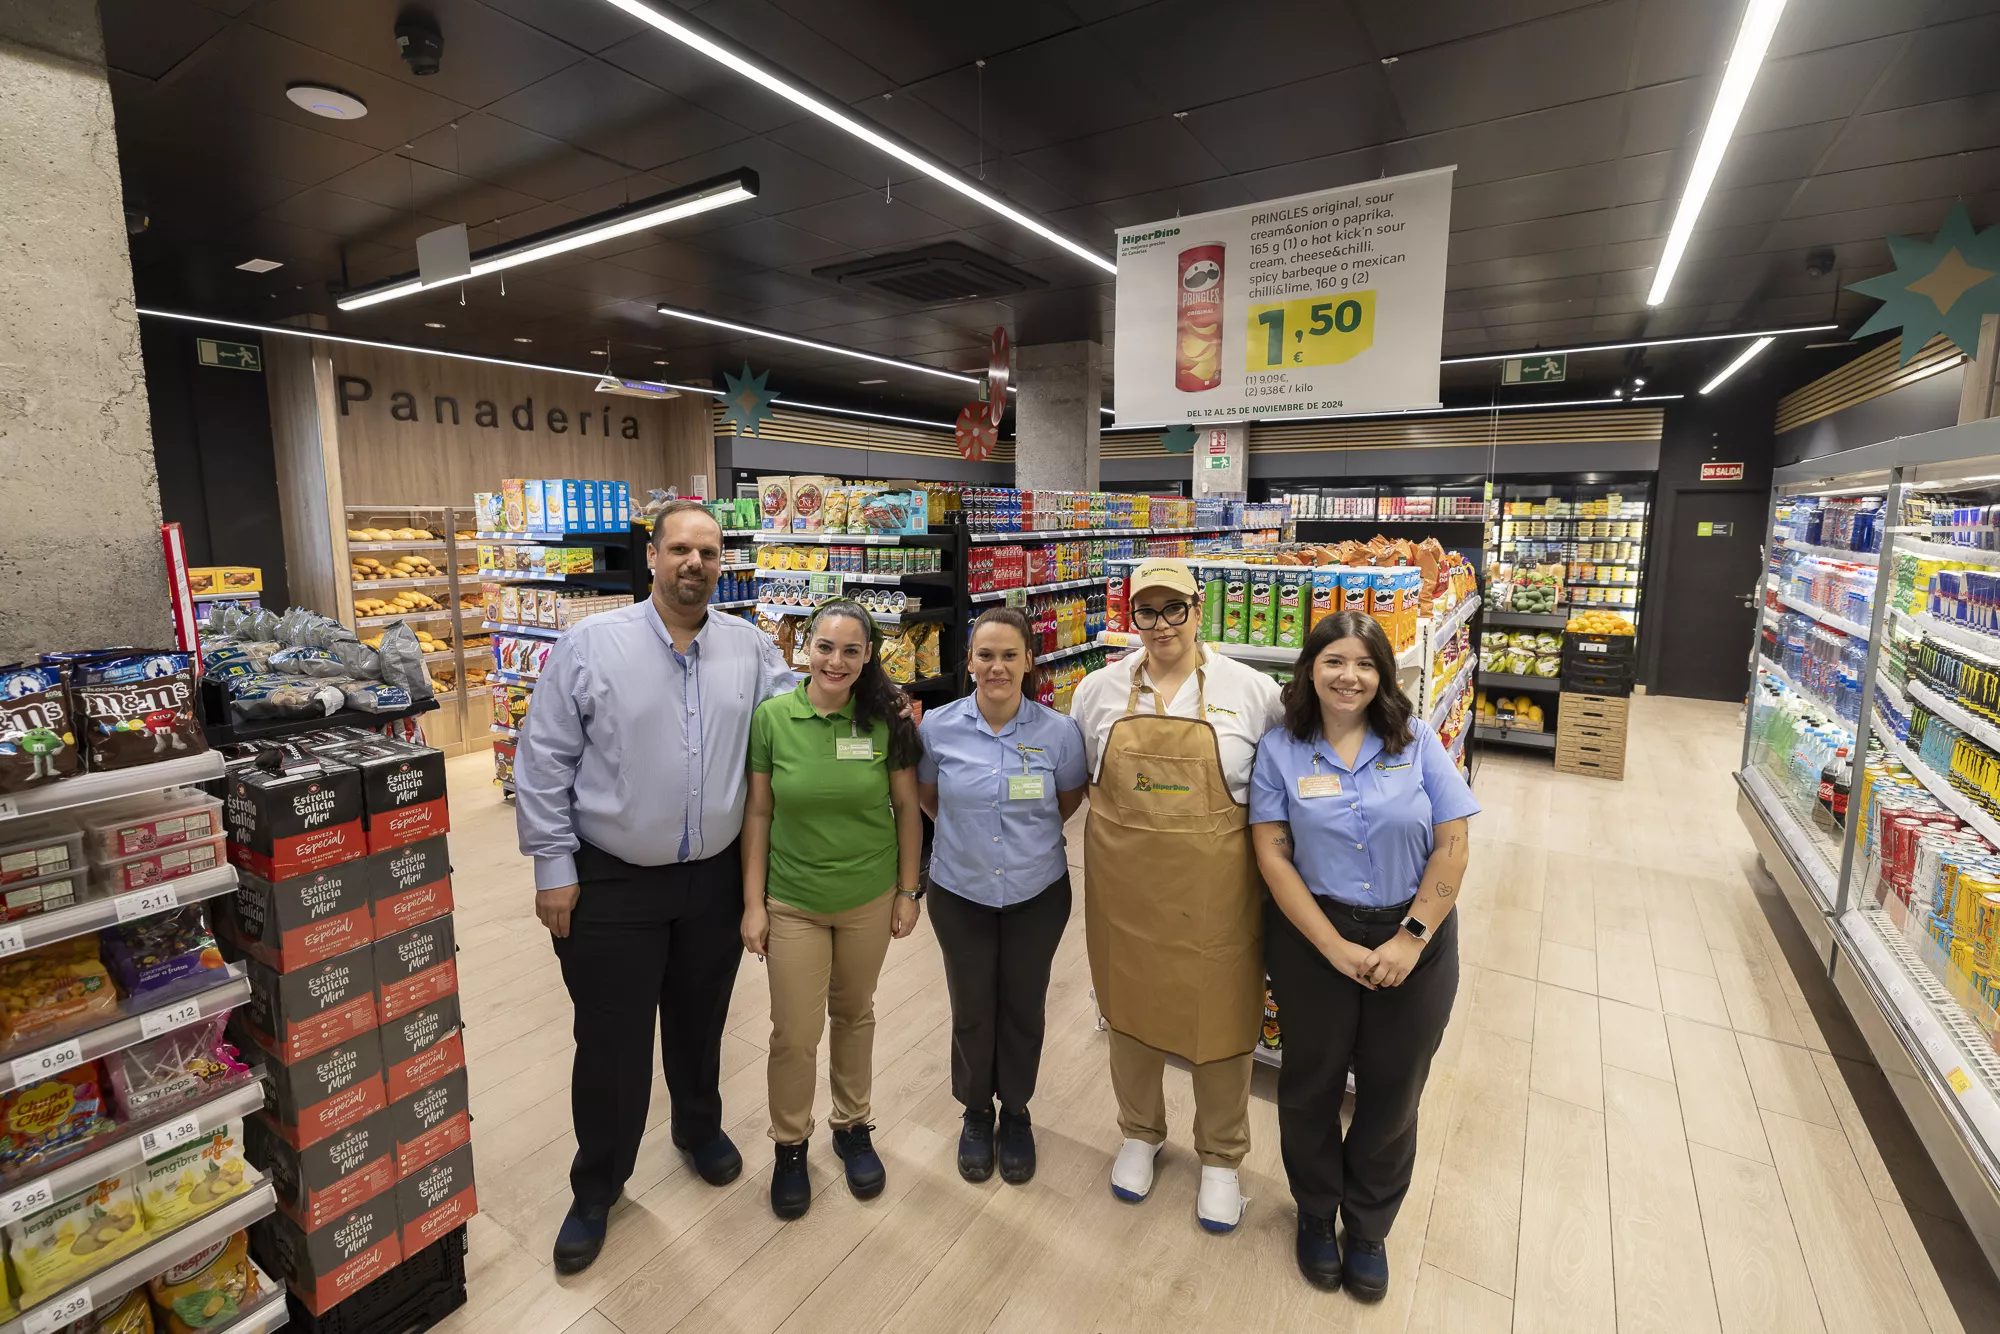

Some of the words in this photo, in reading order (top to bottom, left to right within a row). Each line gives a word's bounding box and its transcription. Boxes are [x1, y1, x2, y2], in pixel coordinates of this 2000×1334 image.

[1252, 207, 1308, 226] PRINGLES
[1312, 197, 1361, 215] original,
[1365, 193, 1394, 206] sour
[1251, 221, 1327, 240] cream&onion
[1344, 209, 1393, 229] paprika,
[1123, 228, 1180, 244] HiperDino
[1251, 243, 1268, 255] 165
[1273, 243, 1279, 254] g
[1283, 237, 1297, 250] (1)
[1312, 234, 1331, 245] hot
[1336, 227, 1372, 241] kick'n
[1377, 222, 1406, 235] sour
[1250, 257, 1286, 269] cream,
[1291, 241, 1374, 264] cheese&chilli,
[1250, 272, 1278, 286] spicy
[1282, 263, 1337, 279] barbeque
[1353, 254, 1405, 269] mexican
[1249, 282, 1312, 298] chilli&lime,
[1317, 277, 1336, 289] 160
[1341, 278, 1348, 289] g
[1352, 271, 1369, 285] (2)
[1183, 288, 1219, 308] PRINGLES
[1294, 351, 1303, 363] €
[1246, 375, 1256, 385] (1)
[1245, 388, 1257, 397] (2)
[1289, 385, 1292, 393] /
[1295, 383, 1313, 393] kilo
[337, 376, 640, 440] Panadería
[1239, 406, 1249, 414] DE
[1253, 403, 1303, 413] NOVIEMBRE
[1307, 402, 1319, 410] DE
[1321, 400, 1343, 408] 2024
[1703, 468, 1715, 476] SIN
[1716, 467, 1740, 475] SALIDA
[1227, 594, 1244, 602] PRINGLES
[1252, 596, 1270, 605] PRINGLES
[1281, 598, 1299, 607] PRINGLES
[1313, 601, 1330, 609] PRINGLES
[1345, 602, 1364, 611] PRINGLES
[1374, 603, 1394, 612] PRINGLES
[80, 684, 138, 692] chocolate
[387, 769, 423, 784] Estrella
[388, 779, 423, 793] Galicia
[1153, 783, 1190, 791] HiperDino
[228, 794, 256, 816] Estrella
[293, 789, 335, 807] Estrella
[396, 790, 418, 804] Mini
[295, 801, 334, 816] Galicia
[399, 808, 422, 817] CERVEZA
[229, 809, 255, 830] Galicia
[304, 812, 330, 828] Mini
[389, 807, 432, 830] Especial
[296, 830, 345, 857] Especial
[307, 831, 333, 842] CERVEZA
[390, 852, 426, 871] Estrella
[392, 862, 425, 878] Galicia
[300, 879, 342, 898] Estrella
[399, 873, 421, 889] Mini
[142, 895, 170, 909] 2,11
[302, 889, 341, 907] Galicia
[393, 889, 436, 915] Especial
[403, 890, 425, 900] CERVEZA
[311, 900, 336, 919] Mini
[304, 918, 353, 947] Especial
[315, 920, 341, 931] CERVEZA
[398, 934, 433, 954] Estrella
[400, 944, 433, 962] Galicia
[139, 964, 171, 977] Caramelos
[408, 954, 430, 972] Mini
[140, 973, 160, 982] sabor
[168, 965, 188, 974] frutas
[308, 966, 349, 988] Estrella
[310, 977, 349, 997] Galicia
[321, 989, 345, 1008] Mini
[168, 1007, 194, 1022] 1,12
[404, 1013, 438, 1034] Estrella
[405, 1023, 438, 1042] Galicia
[413, 1033, 434, 1052] Mini
[42, 1050, 75, 1068] 0,90
[316, 1052, 357, 1074] Estrella
[406, 1048, 447, 1078] Especial
[415, 1052, 437, 1063] CERVEZA
[319, 1061, 356, 1083] Galicia
[164, 1078, 190, 1095] pops
[328, 1072, 351, 1094] Mini
[17, 1088, 68, 1115] Chupa
[319, 1088, 366, 1122] Especial
[330, 1091, 354, 1106] CERVEZA
[413, 1088, 447, 1112] Estrella
[16, 1100, 70, 1127] Chups
[416, 1098, 447, 1119] Galicia
[424, 1109, 444, 1128] Mini
[166, 1124, 193, 1140] 1,38
[329, 1131, 368, 1157] Estrella
[331, 1141, 368, 1164] Galicia
[148, 1154, 198, 1182] Jengibre
[341, 1152, 365, 1175] Mini
[418, 1167, 452, 1191] Estrella
[420, 1176, 452, 1198] Galicia
[12, 1190, 46, 1212] 2,95
[428, 1186, 449, 1207] Mini
[421, 1200, 461, 1233] Especial
[429, 1203, 451, 1218] CERVEZA
[24, 1202, 82, 1239] Jengibre
[333, 1214, 373, 1241] Estrella
[336, 1223, 372, 1249] Galicia
[344, 1236, 368, 1259] Mini
[336, 1249, 382, 1287] Especial
[346, 1253, 370, 1270] CERVEZA
[53, 1298, 85, 1321] 2,39
